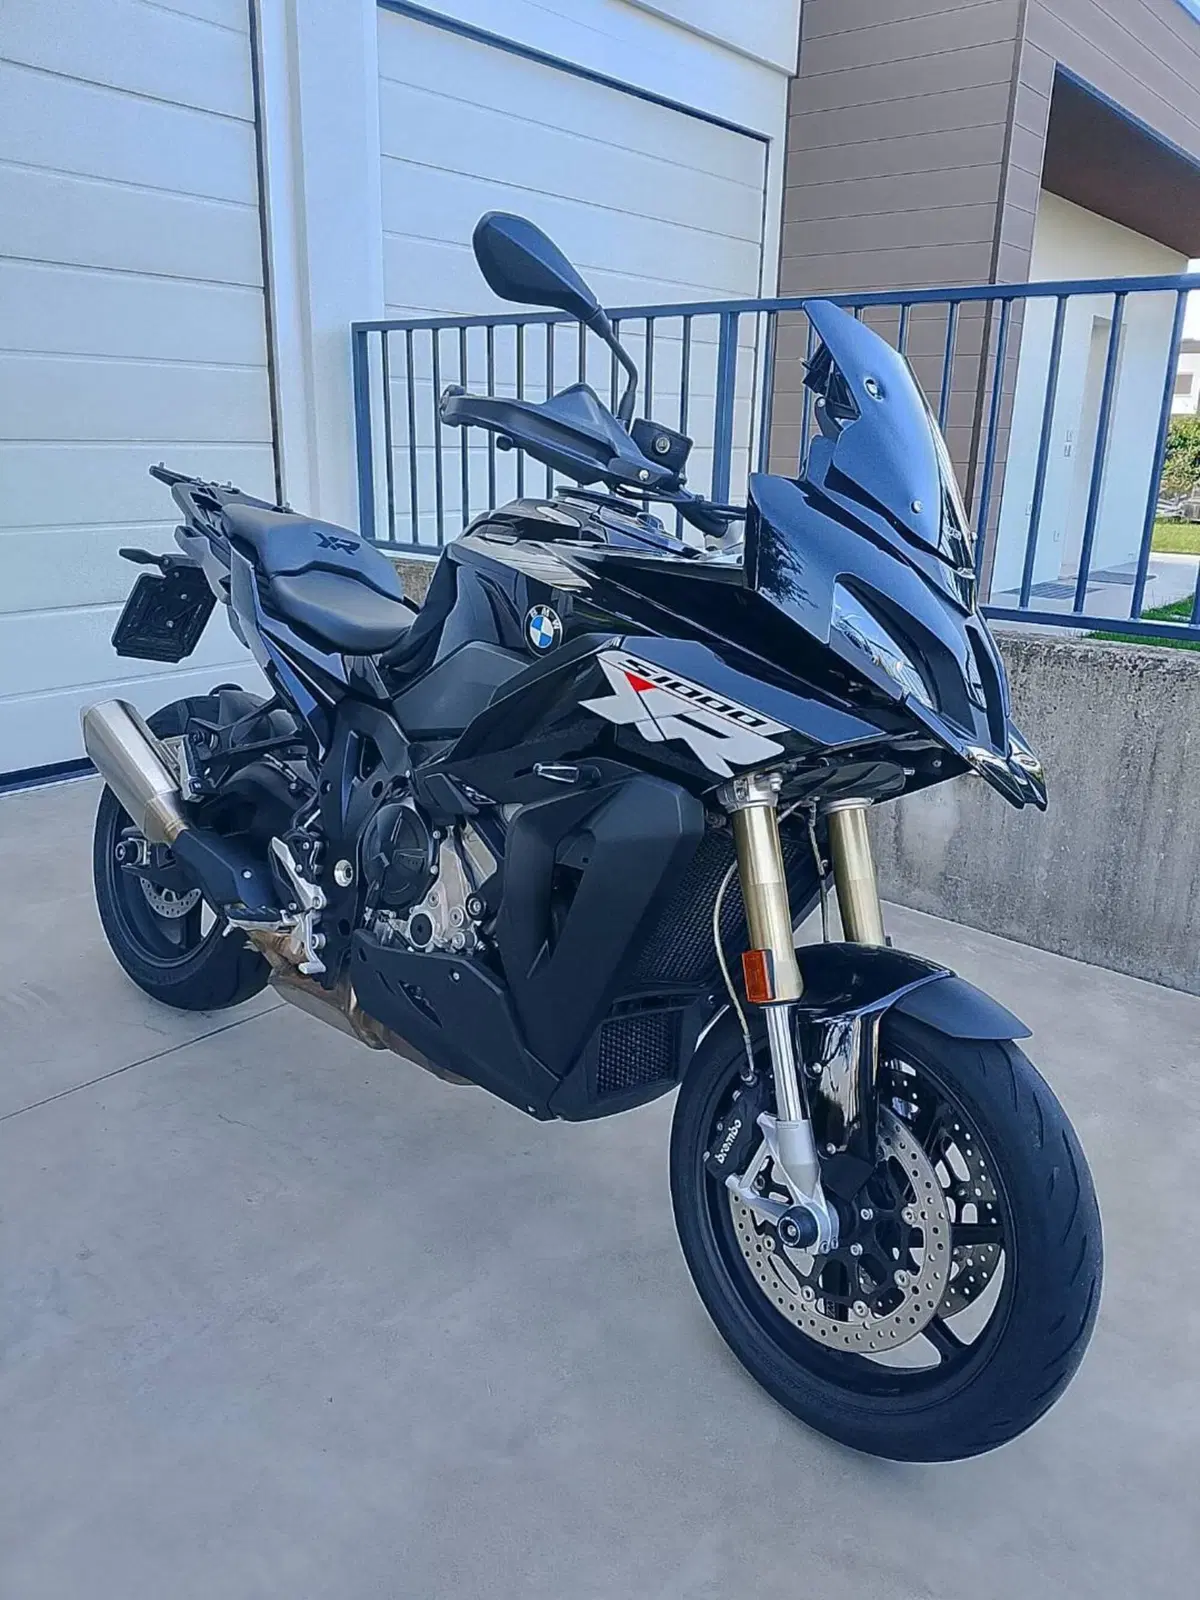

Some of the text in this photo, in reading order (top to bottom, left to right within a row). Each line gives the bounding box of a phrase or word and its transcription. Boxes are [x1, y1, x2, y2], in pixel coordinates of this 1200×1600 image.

[312, 531, 361, 556] XR
[530, 607, 560, 630] BMW
[618, 659, 768, 728] S1000
[578, 656, 785, 778] XR
[714, 1119, 742, 1164] brembo
